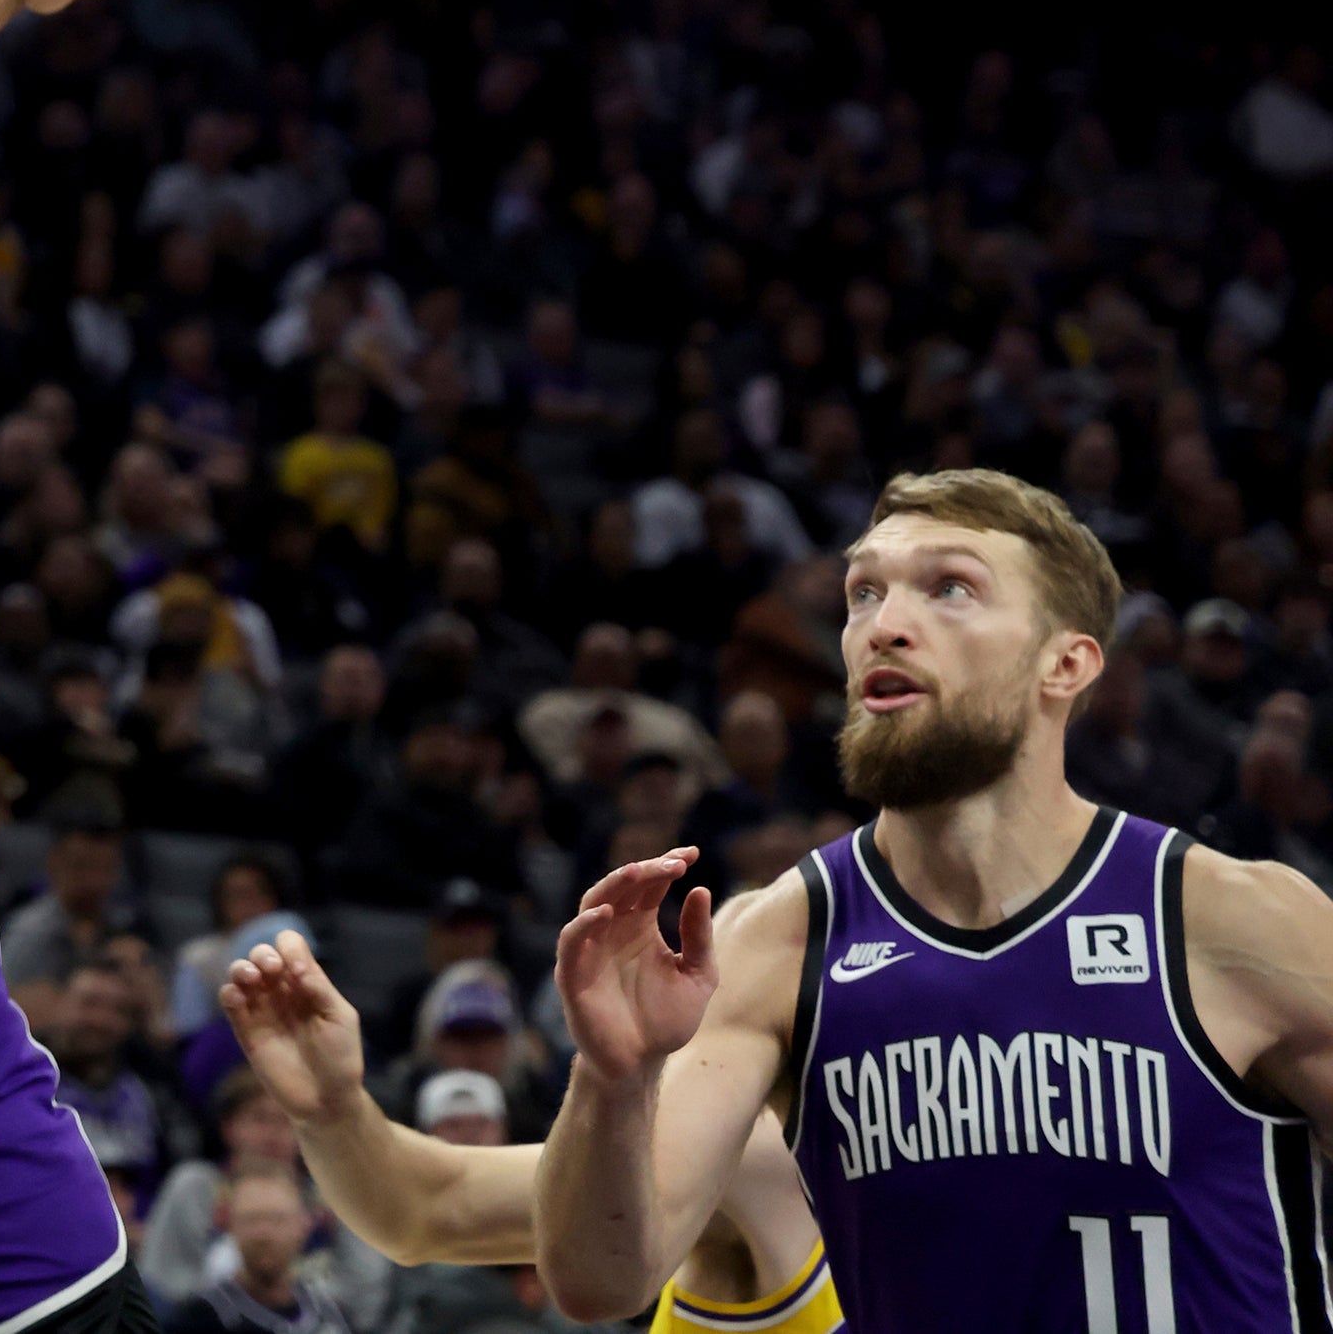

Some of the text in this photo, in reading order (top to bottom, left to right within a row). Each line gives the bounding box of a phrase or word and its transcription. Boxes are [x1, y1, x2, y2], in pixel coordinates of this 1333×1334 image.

[843, 941, 897, 967] NIKE
[1077, 965, 1144, 976] REVIVER
[823, 1032, 1171, 1181] SACRAMENTO
[1069, 1215, 1177, 1334] 11
